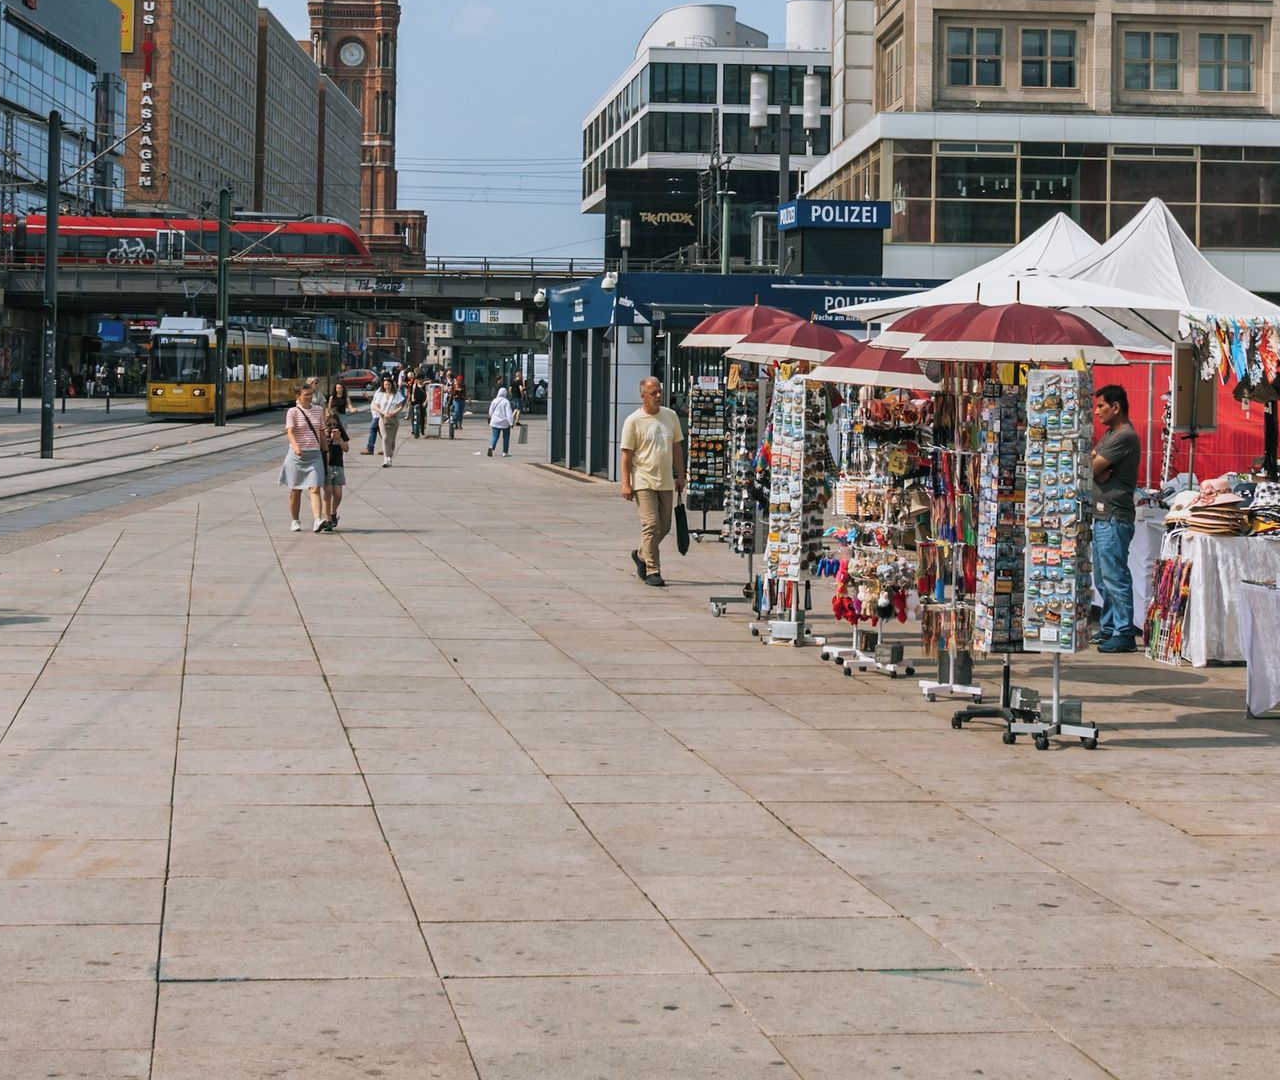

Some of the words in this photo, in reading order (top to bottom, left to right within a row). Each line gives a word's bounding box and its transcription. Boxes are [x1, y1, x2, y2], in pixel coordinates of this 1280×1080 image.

[139, 82, 154, 187] PASSAGEN
[811, 205, 877, 223] POLIZEI
[455, 309, 466, 322] U
